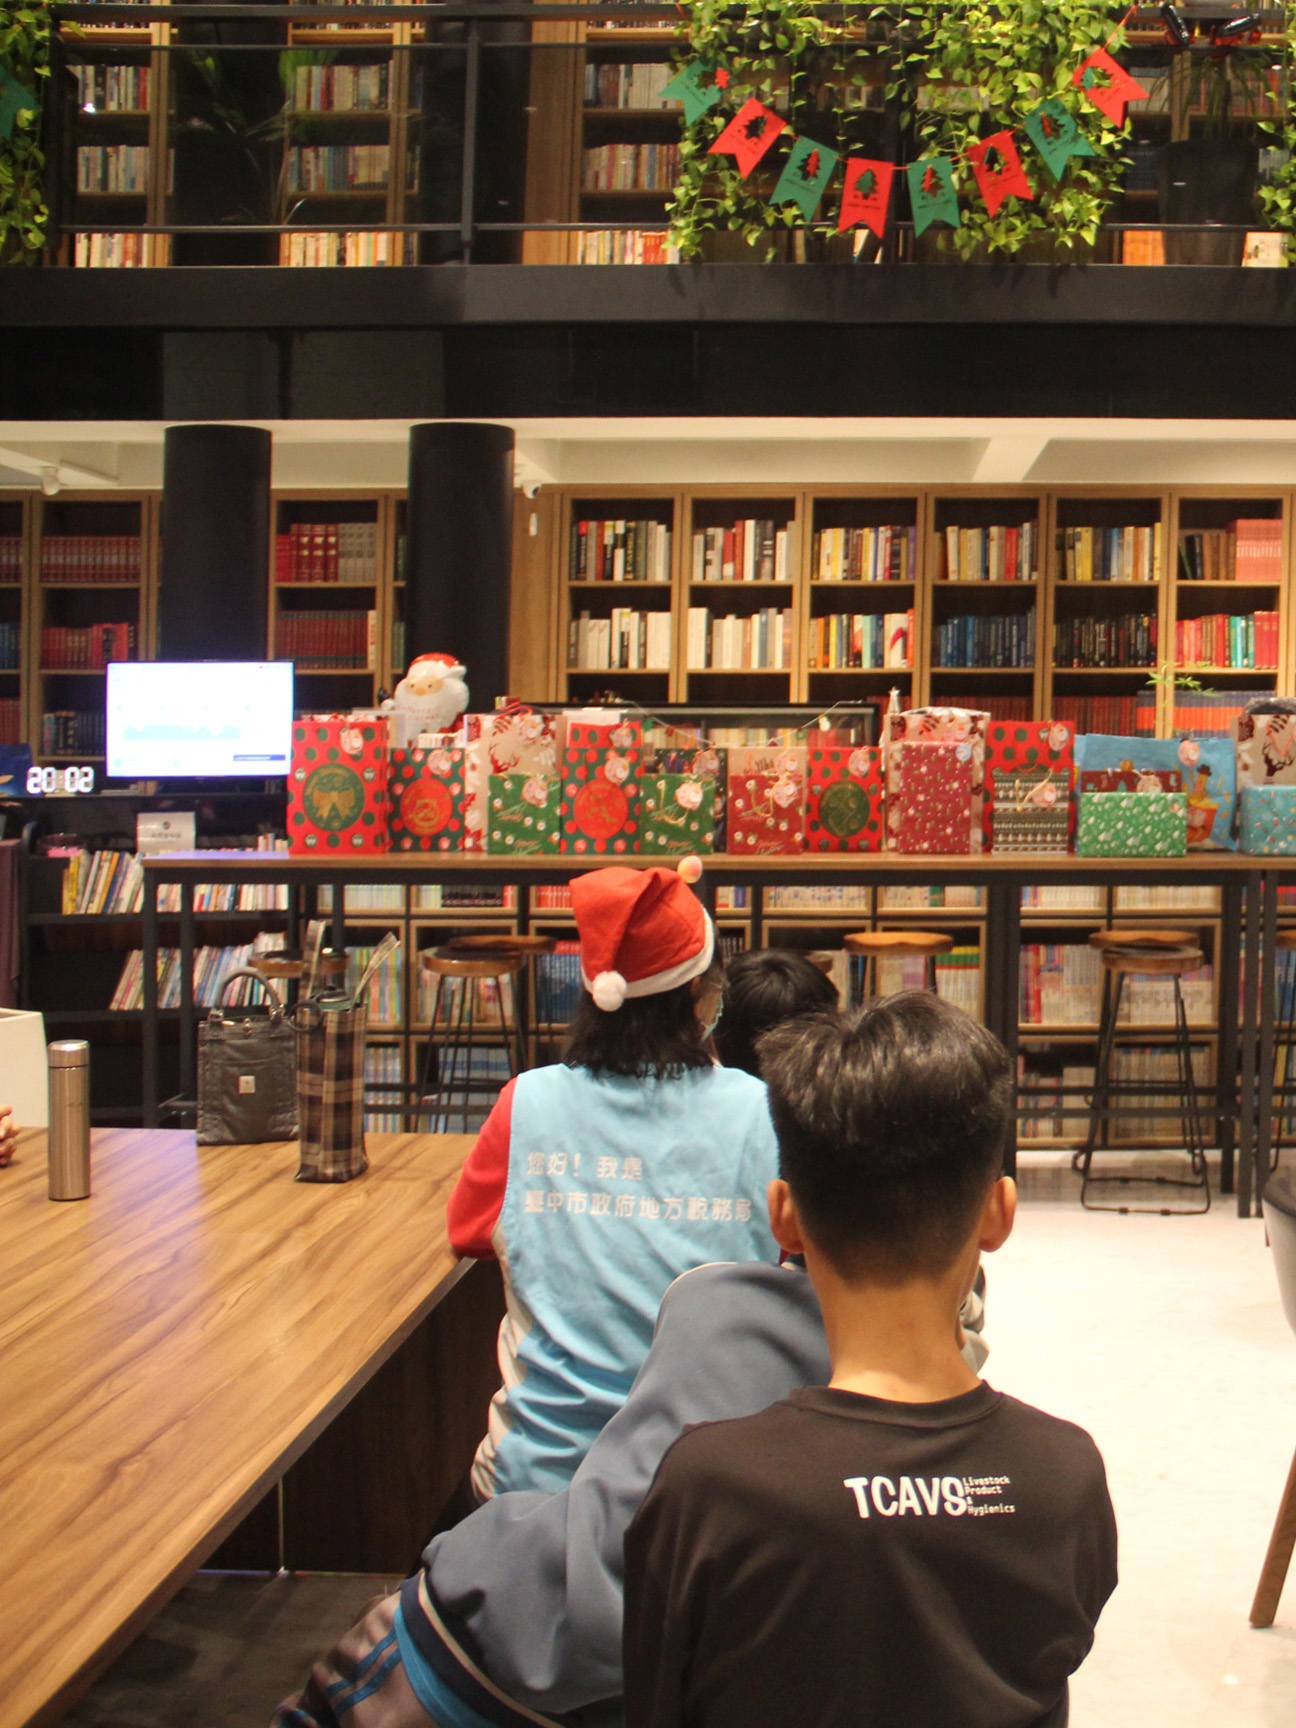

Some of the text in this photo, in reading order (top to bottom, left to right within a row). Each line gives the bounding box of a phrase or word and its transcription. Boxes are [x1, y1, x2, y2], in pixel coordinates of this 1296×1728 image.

[26, 766, 94, 794] 20:02
[962, 1475, 1011, 1487] Livestock
[843, 1475, 967, 1519] TCAVS
[964, 1485, 1003, 1496] Product
[967, 1503, 1016, 1517] Hygienics
